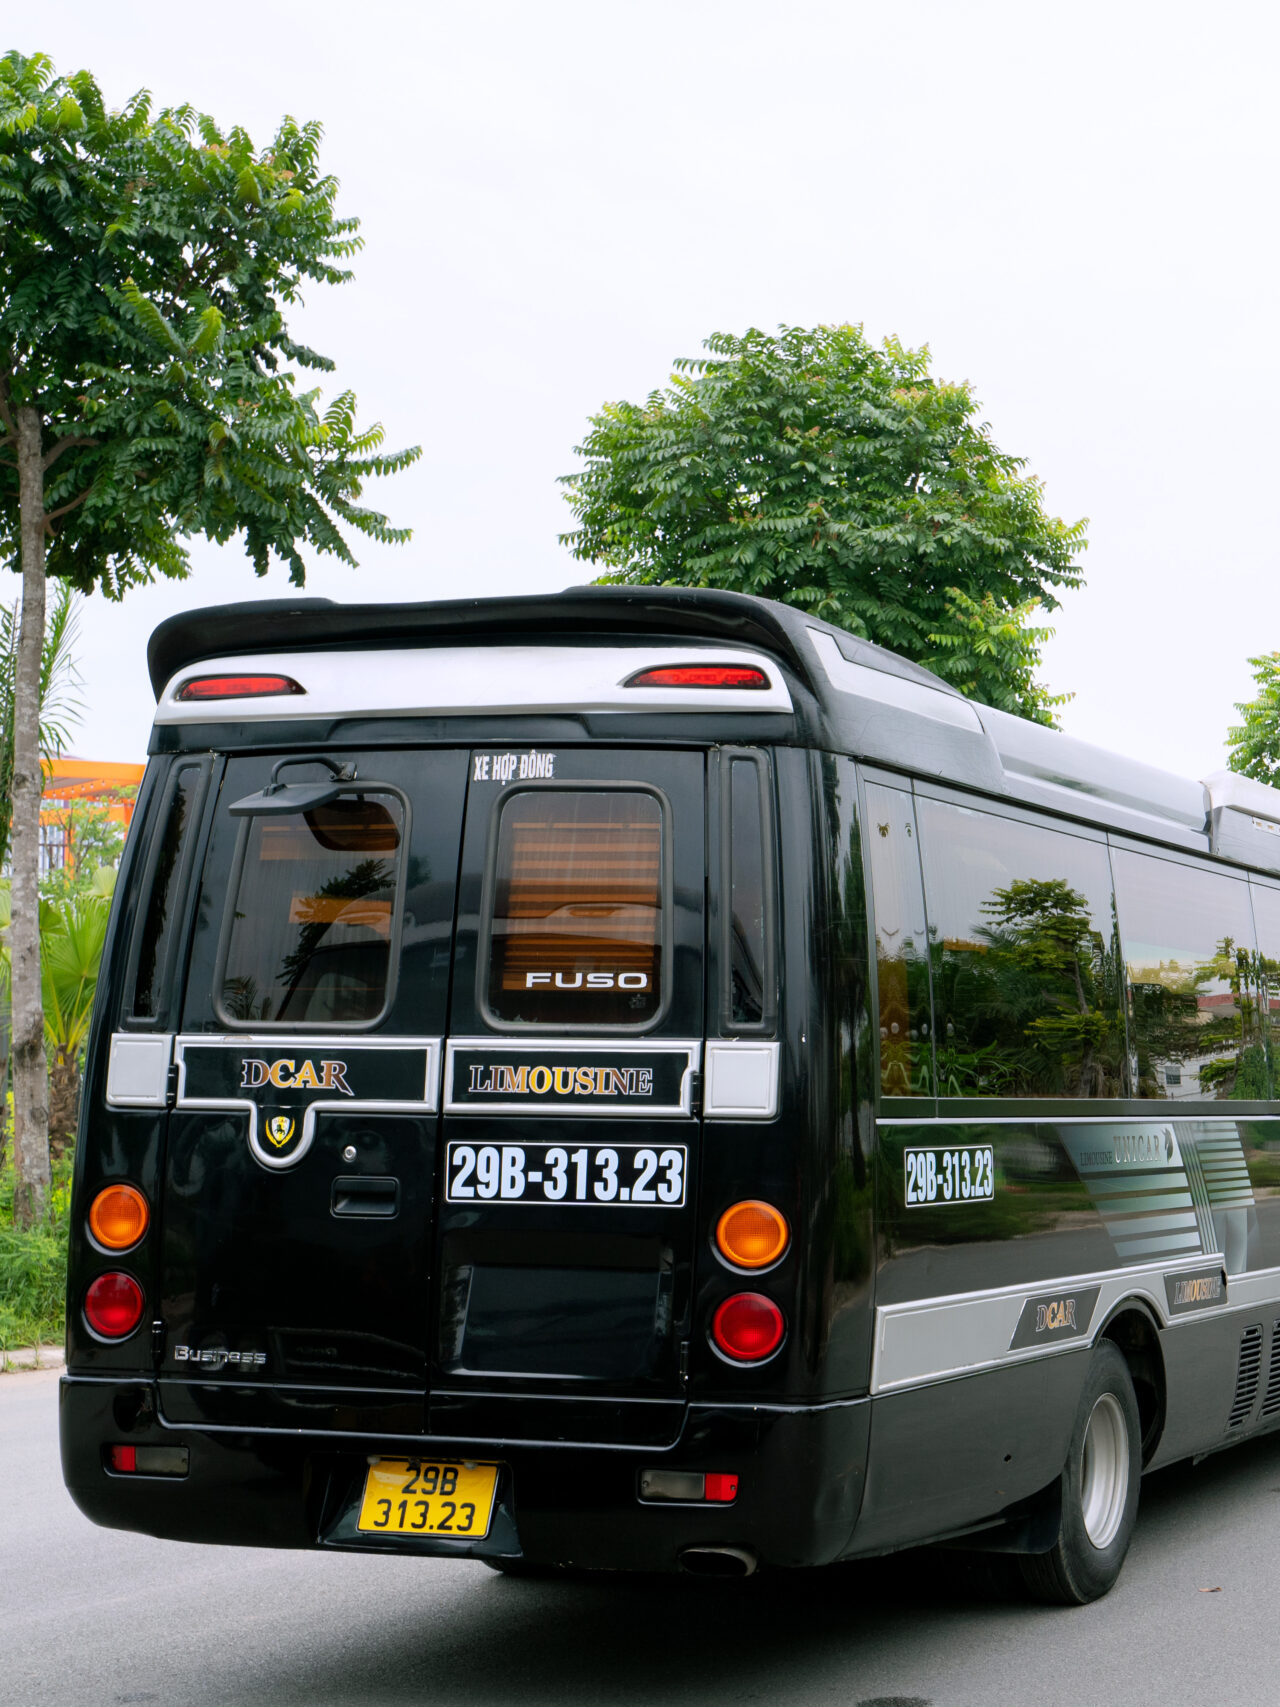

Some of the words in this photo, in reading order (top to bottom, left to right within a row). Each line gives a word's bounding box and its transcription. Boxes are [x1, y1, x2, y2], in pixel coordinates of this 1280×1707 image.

[474, 754, 490, 781] XE
[525, 972, 648, 989] FUSO
[240, 1059, 355, 1097] DCAR
[468, 1065, 653, 1096] LIMOUSINE
[1113, 1135, 1162, 1164] UNICAR
[450, 1146, 683, 1203] 29B-313.23
[907, 1149, 993, 1203] 29B-313.23
[1174, 1276, 1221, 1305] LIMOUSINE
[1036, 1300, 1077, 1332] DCAR
[174, 1345, 267, 1364] Business
[401, 1466, 459, 1496] 29B
[373, 1498, 476, 1532] 313.23
